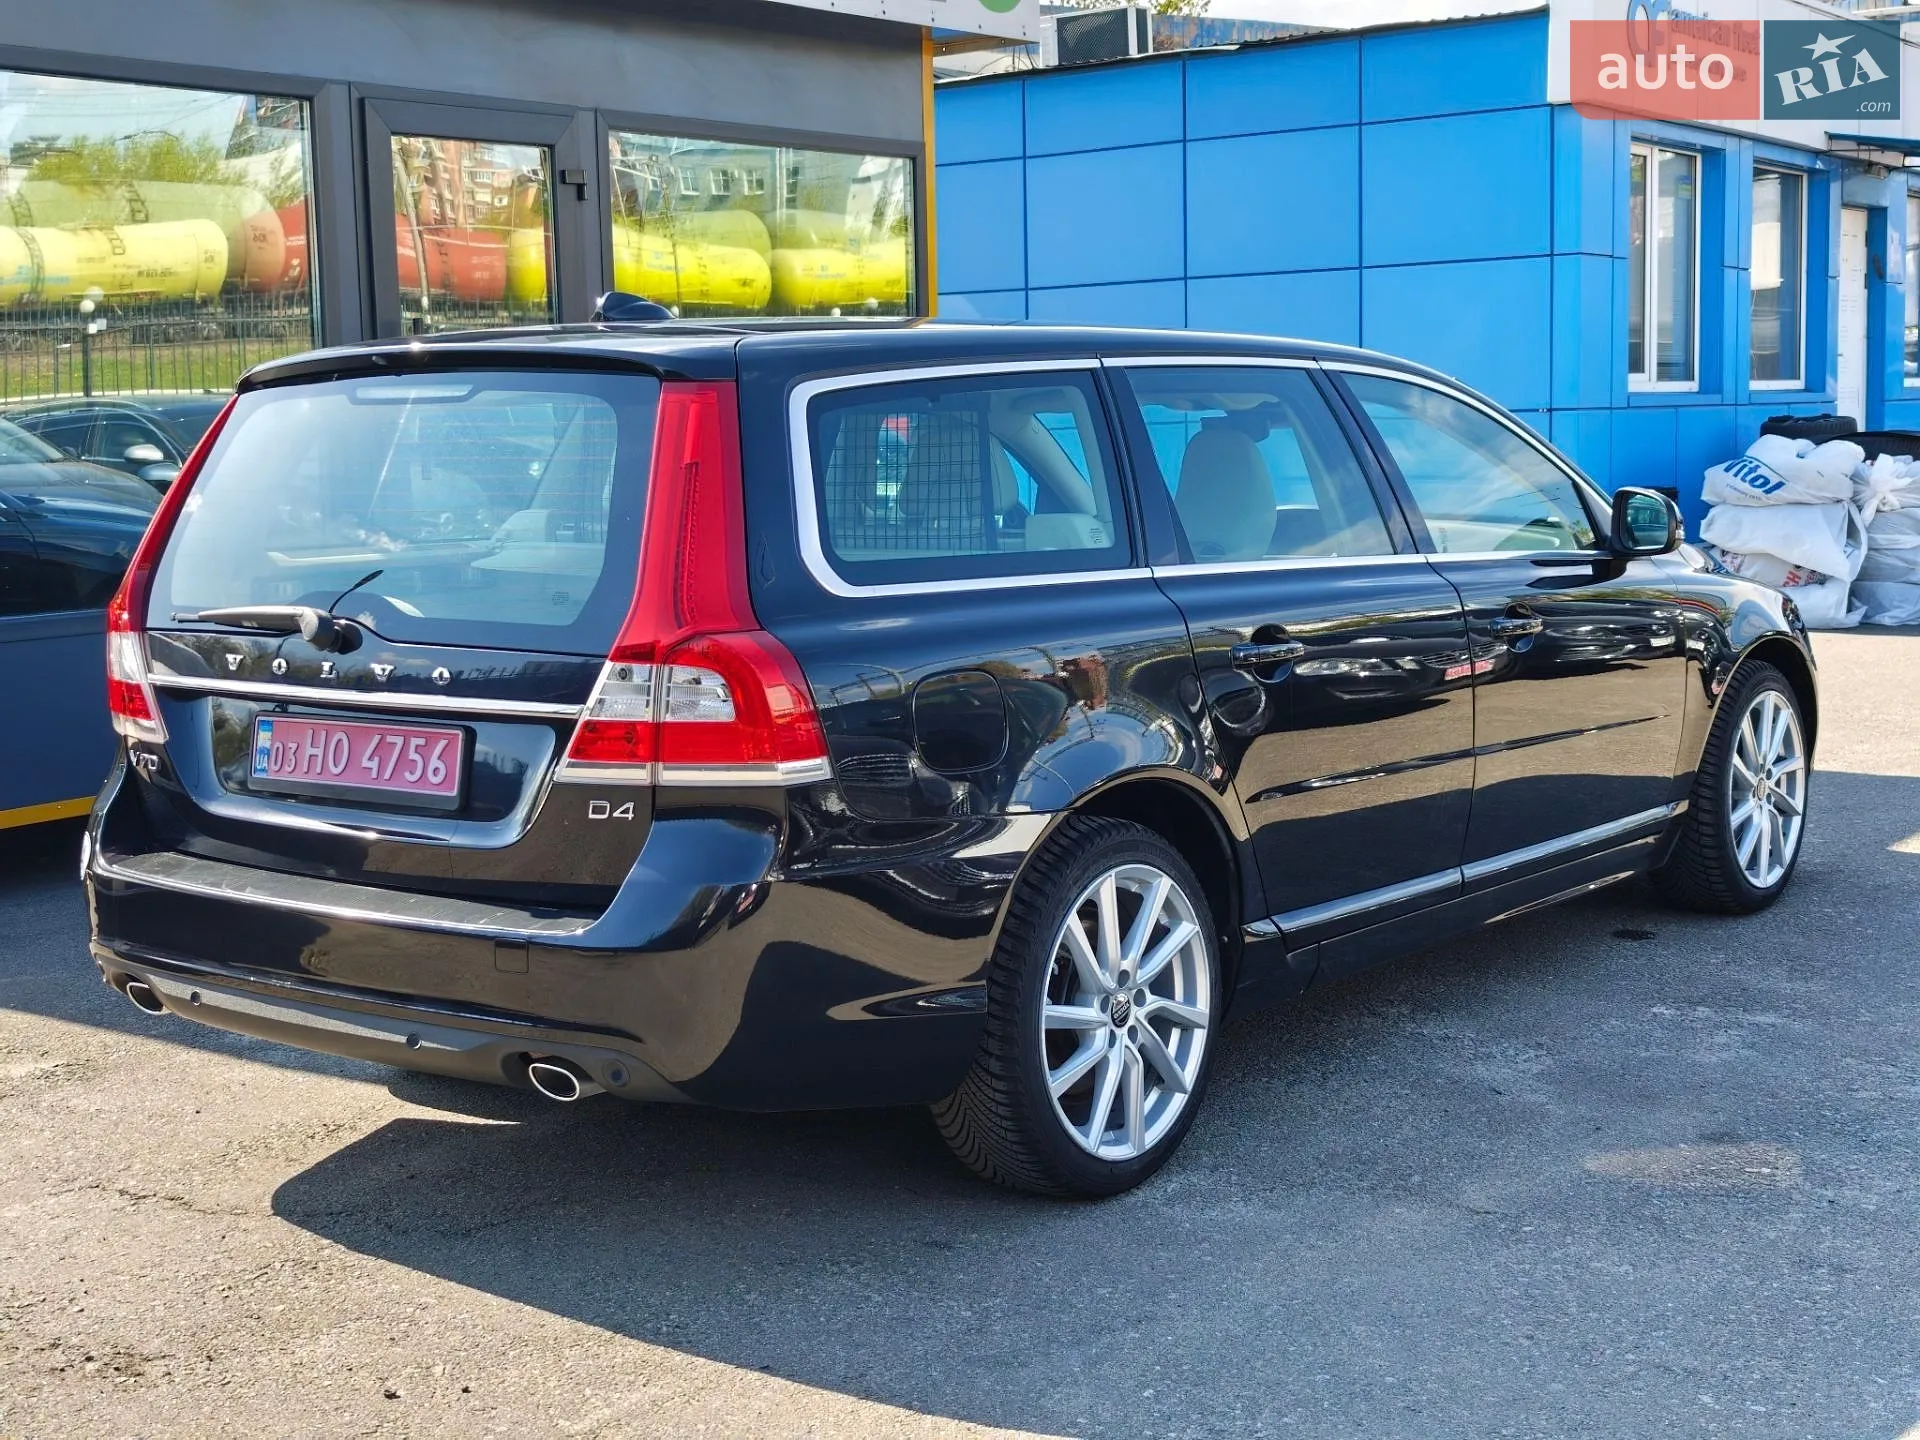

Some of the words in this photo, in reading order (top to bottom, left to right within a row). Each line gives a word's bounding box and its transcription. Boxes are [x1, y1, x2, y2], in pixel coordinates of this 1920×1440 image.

[1723, 459, 1785, 494] Vitol
[225, 653, 451, 685] VOLVO
[256, 755, 269, 769] UA
[271, 741, 299, 773] 03
[303, 728, 351, 776] HO
[361, 734, 449, 785] 4756
[588, 800, 634, 820] D4
